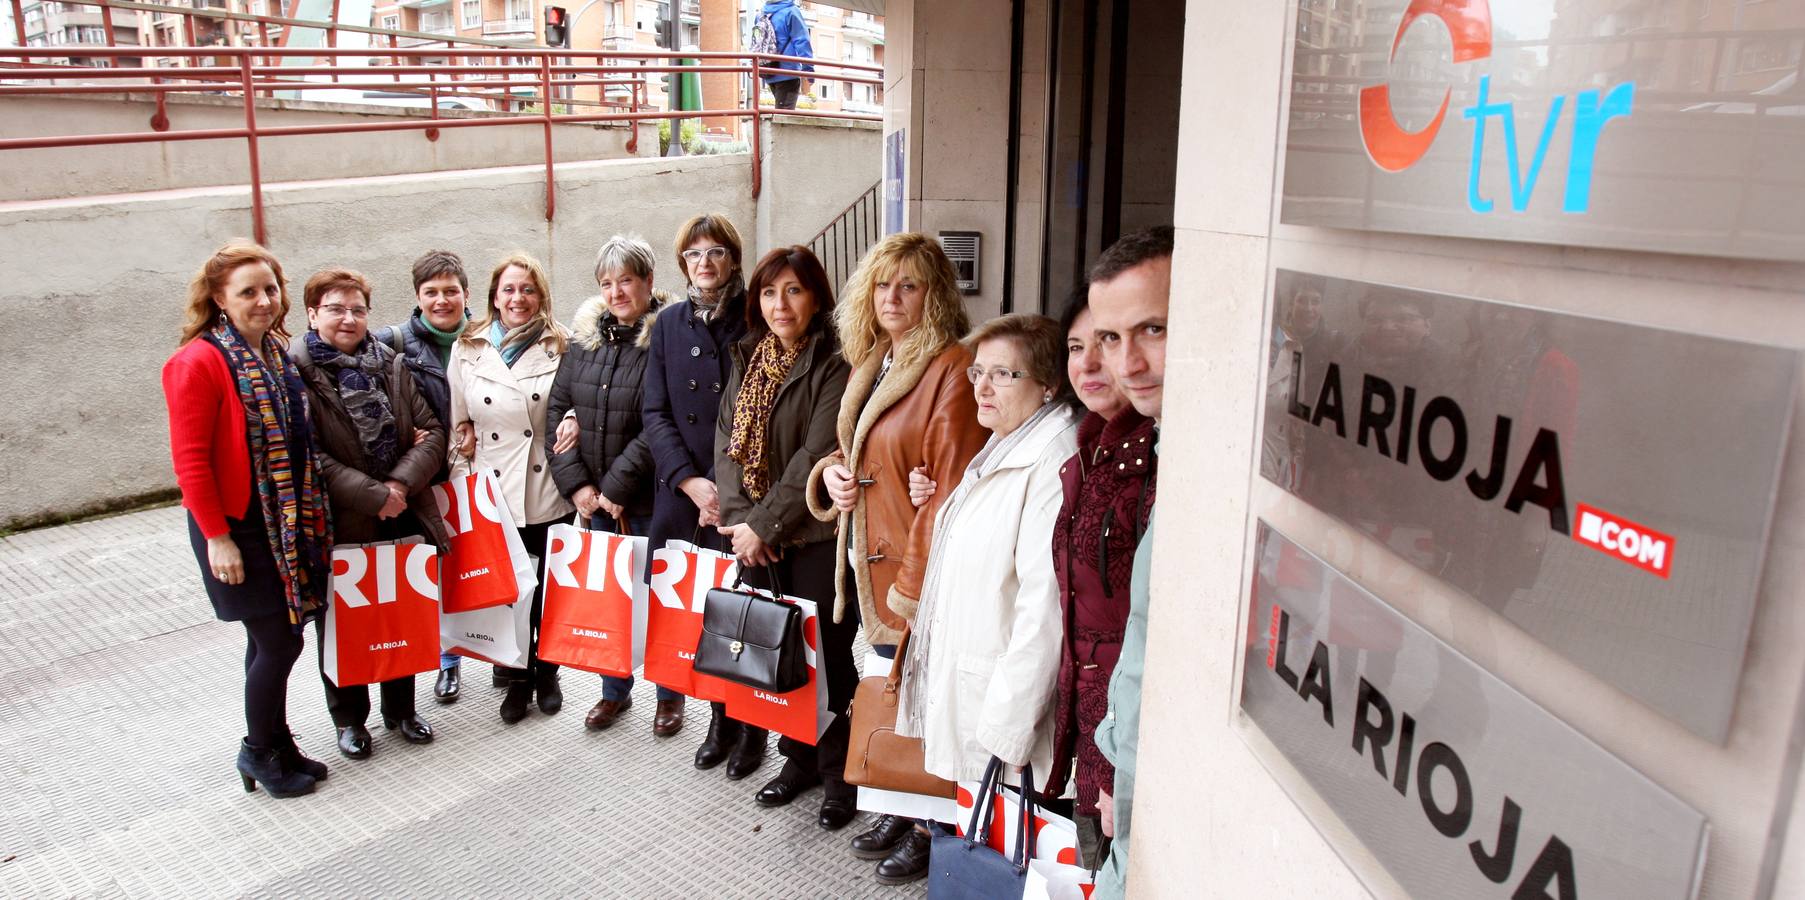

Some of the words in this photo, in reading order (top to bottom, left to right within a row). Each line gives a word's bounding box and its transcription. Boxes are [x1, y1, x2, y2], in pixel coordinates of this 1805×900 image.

[1463, 74, 1636, 213] tvr
[1288, 351, 1346, 438] LA
[1357, 374, 1571, 536] RIOJA
[371, 643, 382, 651] LA
[383, 640, 408, 649] RIOJA
[585, 630, 608, 639] RIOJA
[765, 694, 788, 706] RIOJA
[1275, 609, 1334, 729] LA
[1351, 676, 1578, 900] RIOJA
